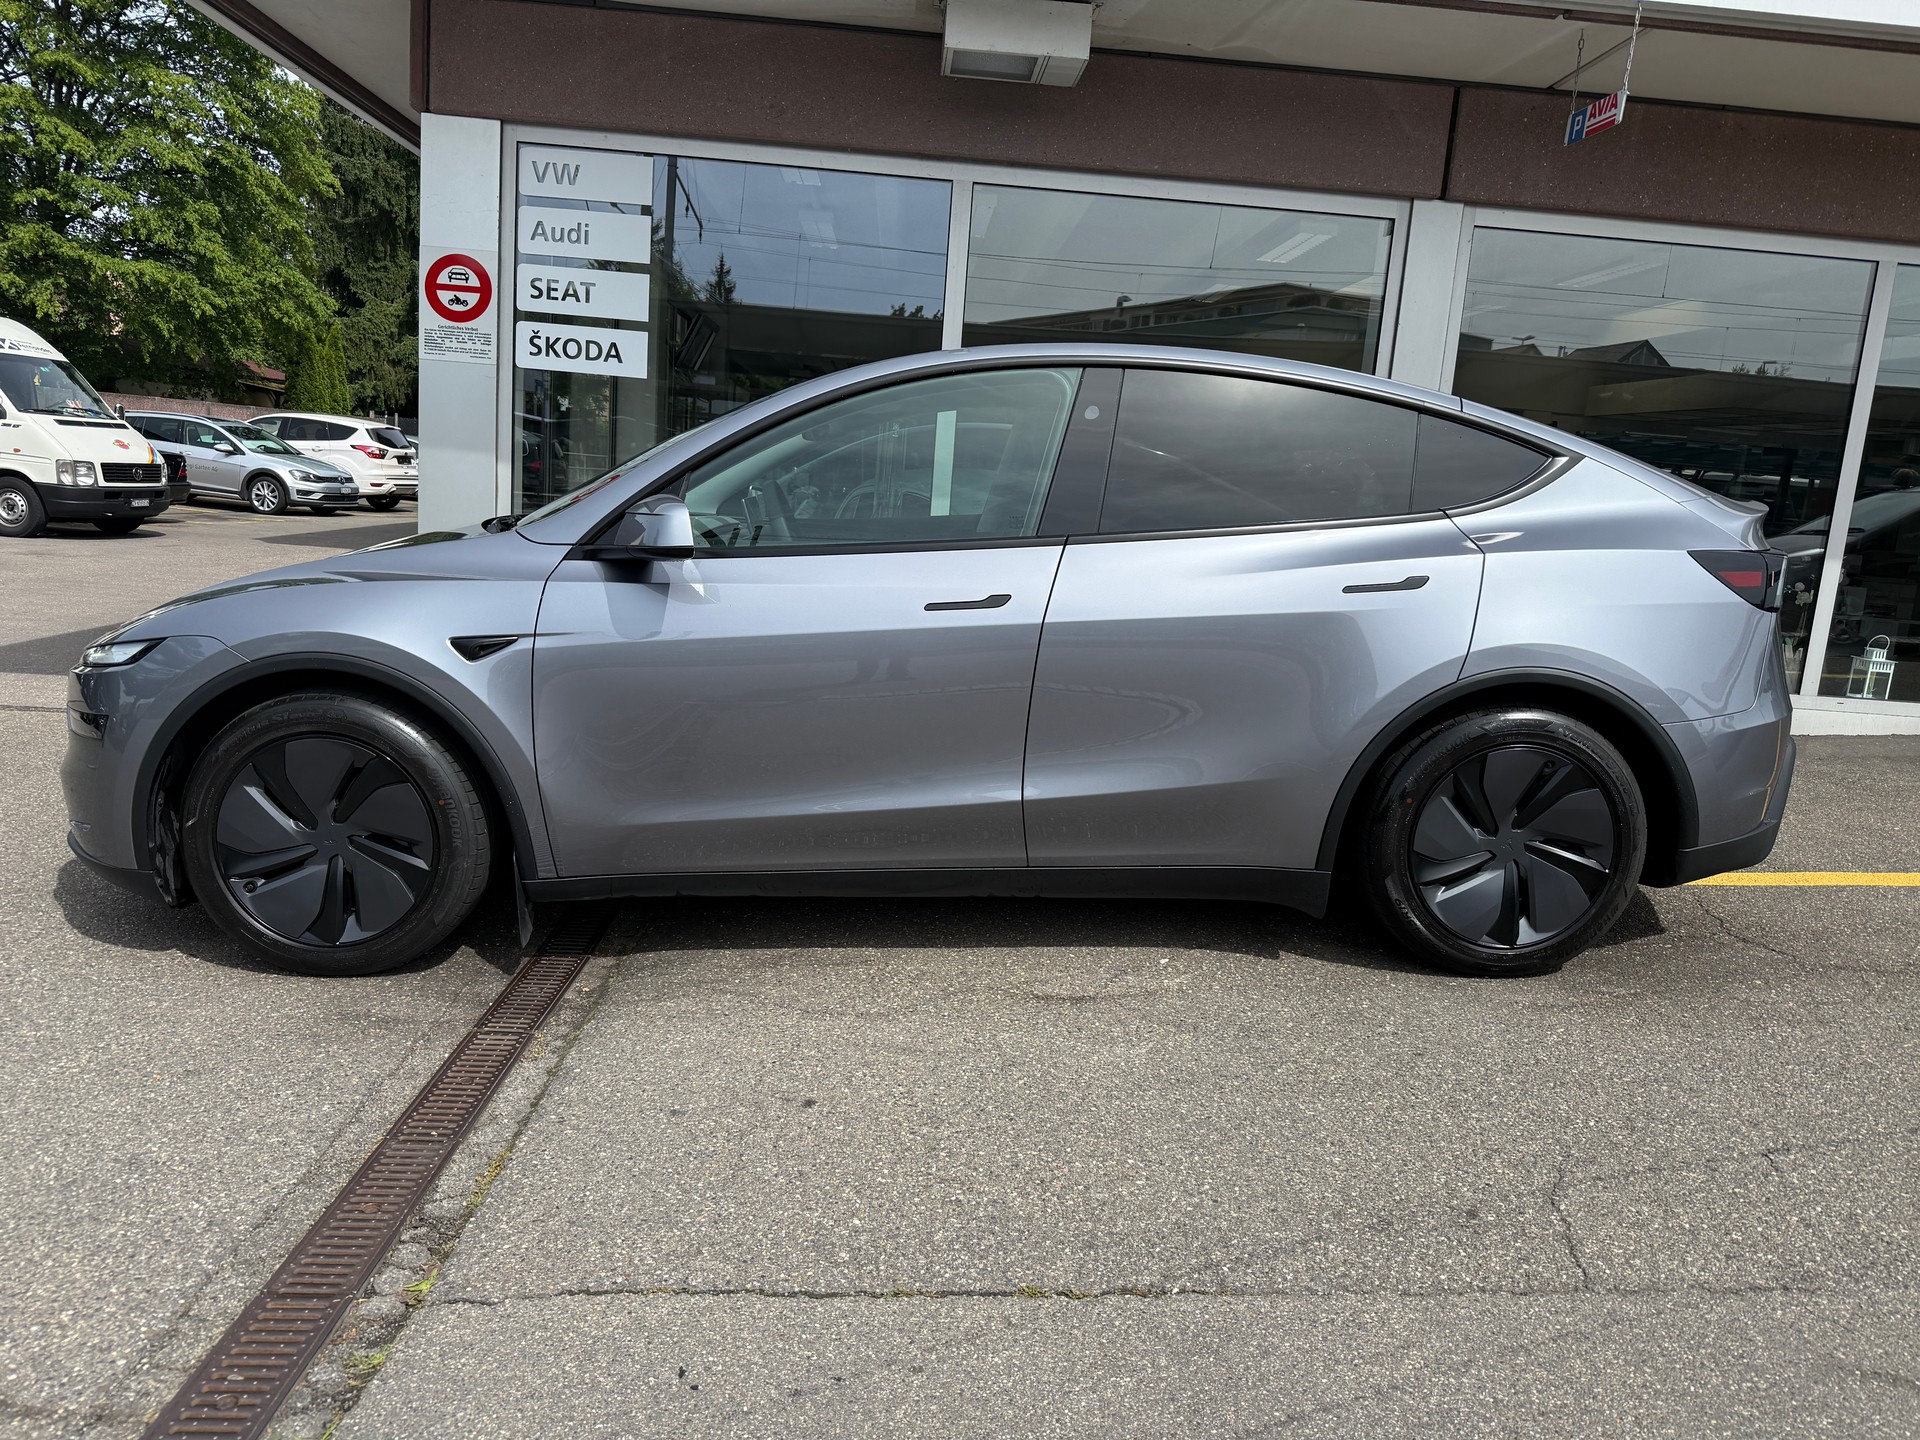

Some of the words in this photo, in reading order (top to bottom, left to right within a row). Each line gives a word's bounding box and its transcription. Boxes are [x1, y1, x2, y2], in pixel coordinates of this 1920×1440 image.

[1571, 115, 1583, 139] P
[1588, 92, 1618, 122] AVIA
[531, 160, 581, 186] VW
[530, 220, 590, 245] Audi
[529, 277, 597, 304] SEAT
[528, 329, 624, 364] ŠKODA
